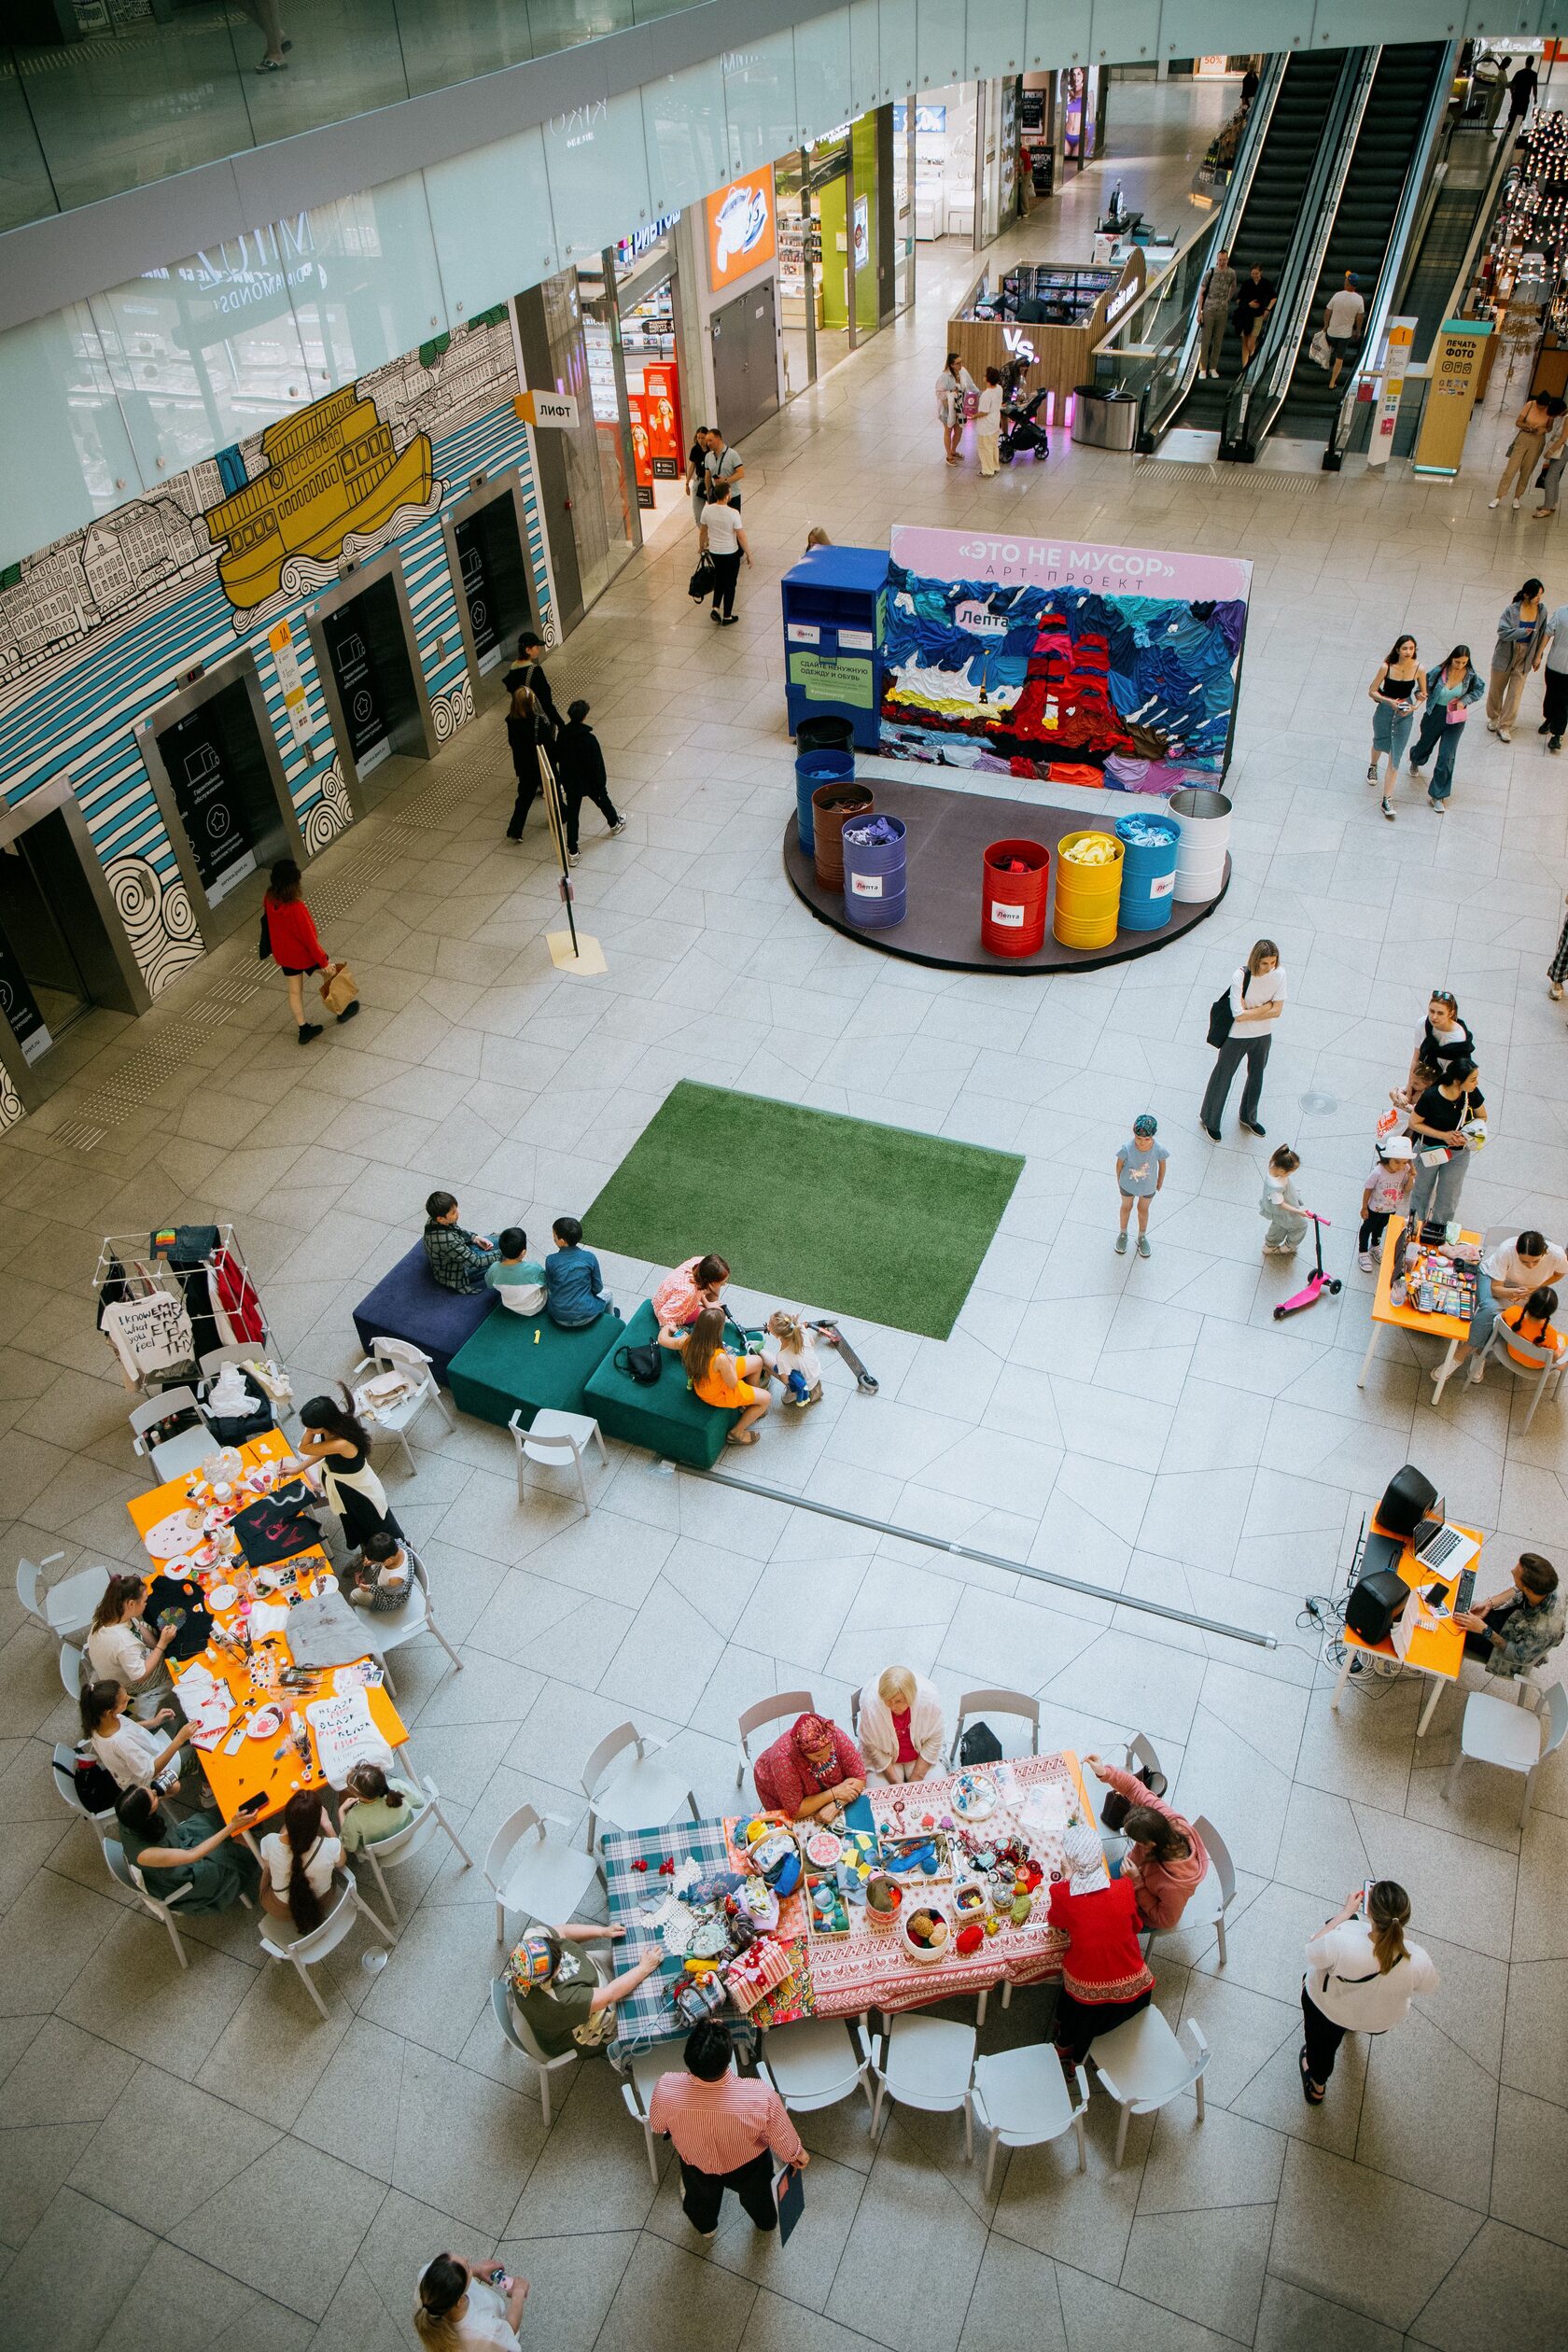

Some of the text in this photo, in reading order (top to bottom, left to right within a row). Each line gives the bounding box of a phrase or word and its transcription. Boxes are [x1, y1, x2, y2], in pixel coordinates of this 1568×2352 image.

[1447, 339, 1477, 348] ПЕЧАТЬ
[1446, 347, 1475, 358] ФОТО
[540, 404, 570, 417] ЛИФТ
[959, 540, 1176, 578] «ЭТО НЕ МУСОР»
[959, 610, 1009, 627] Лепта
[800, 660, 868, 675] СДАЙТЕ НЕНУЖНУЮ
[800, 667, 830, 678] ОДЕЖДУ
[837, 673, 861, 681] ОБУВЬ
[856, 882, 878, 890] Лепта
[997, 911, 1020, 919] Лепта
[125, 1310, 151, 1323] know
[123, 1321, 148, 1335] what
[150, 1320, 179, 1337] EM
[167, 1327, 189, 1343] PA
[129, 1333, 147, 1345] you
[135, 1337, 156, 1353] feel
[161, 1338, 193, 1357] THY
